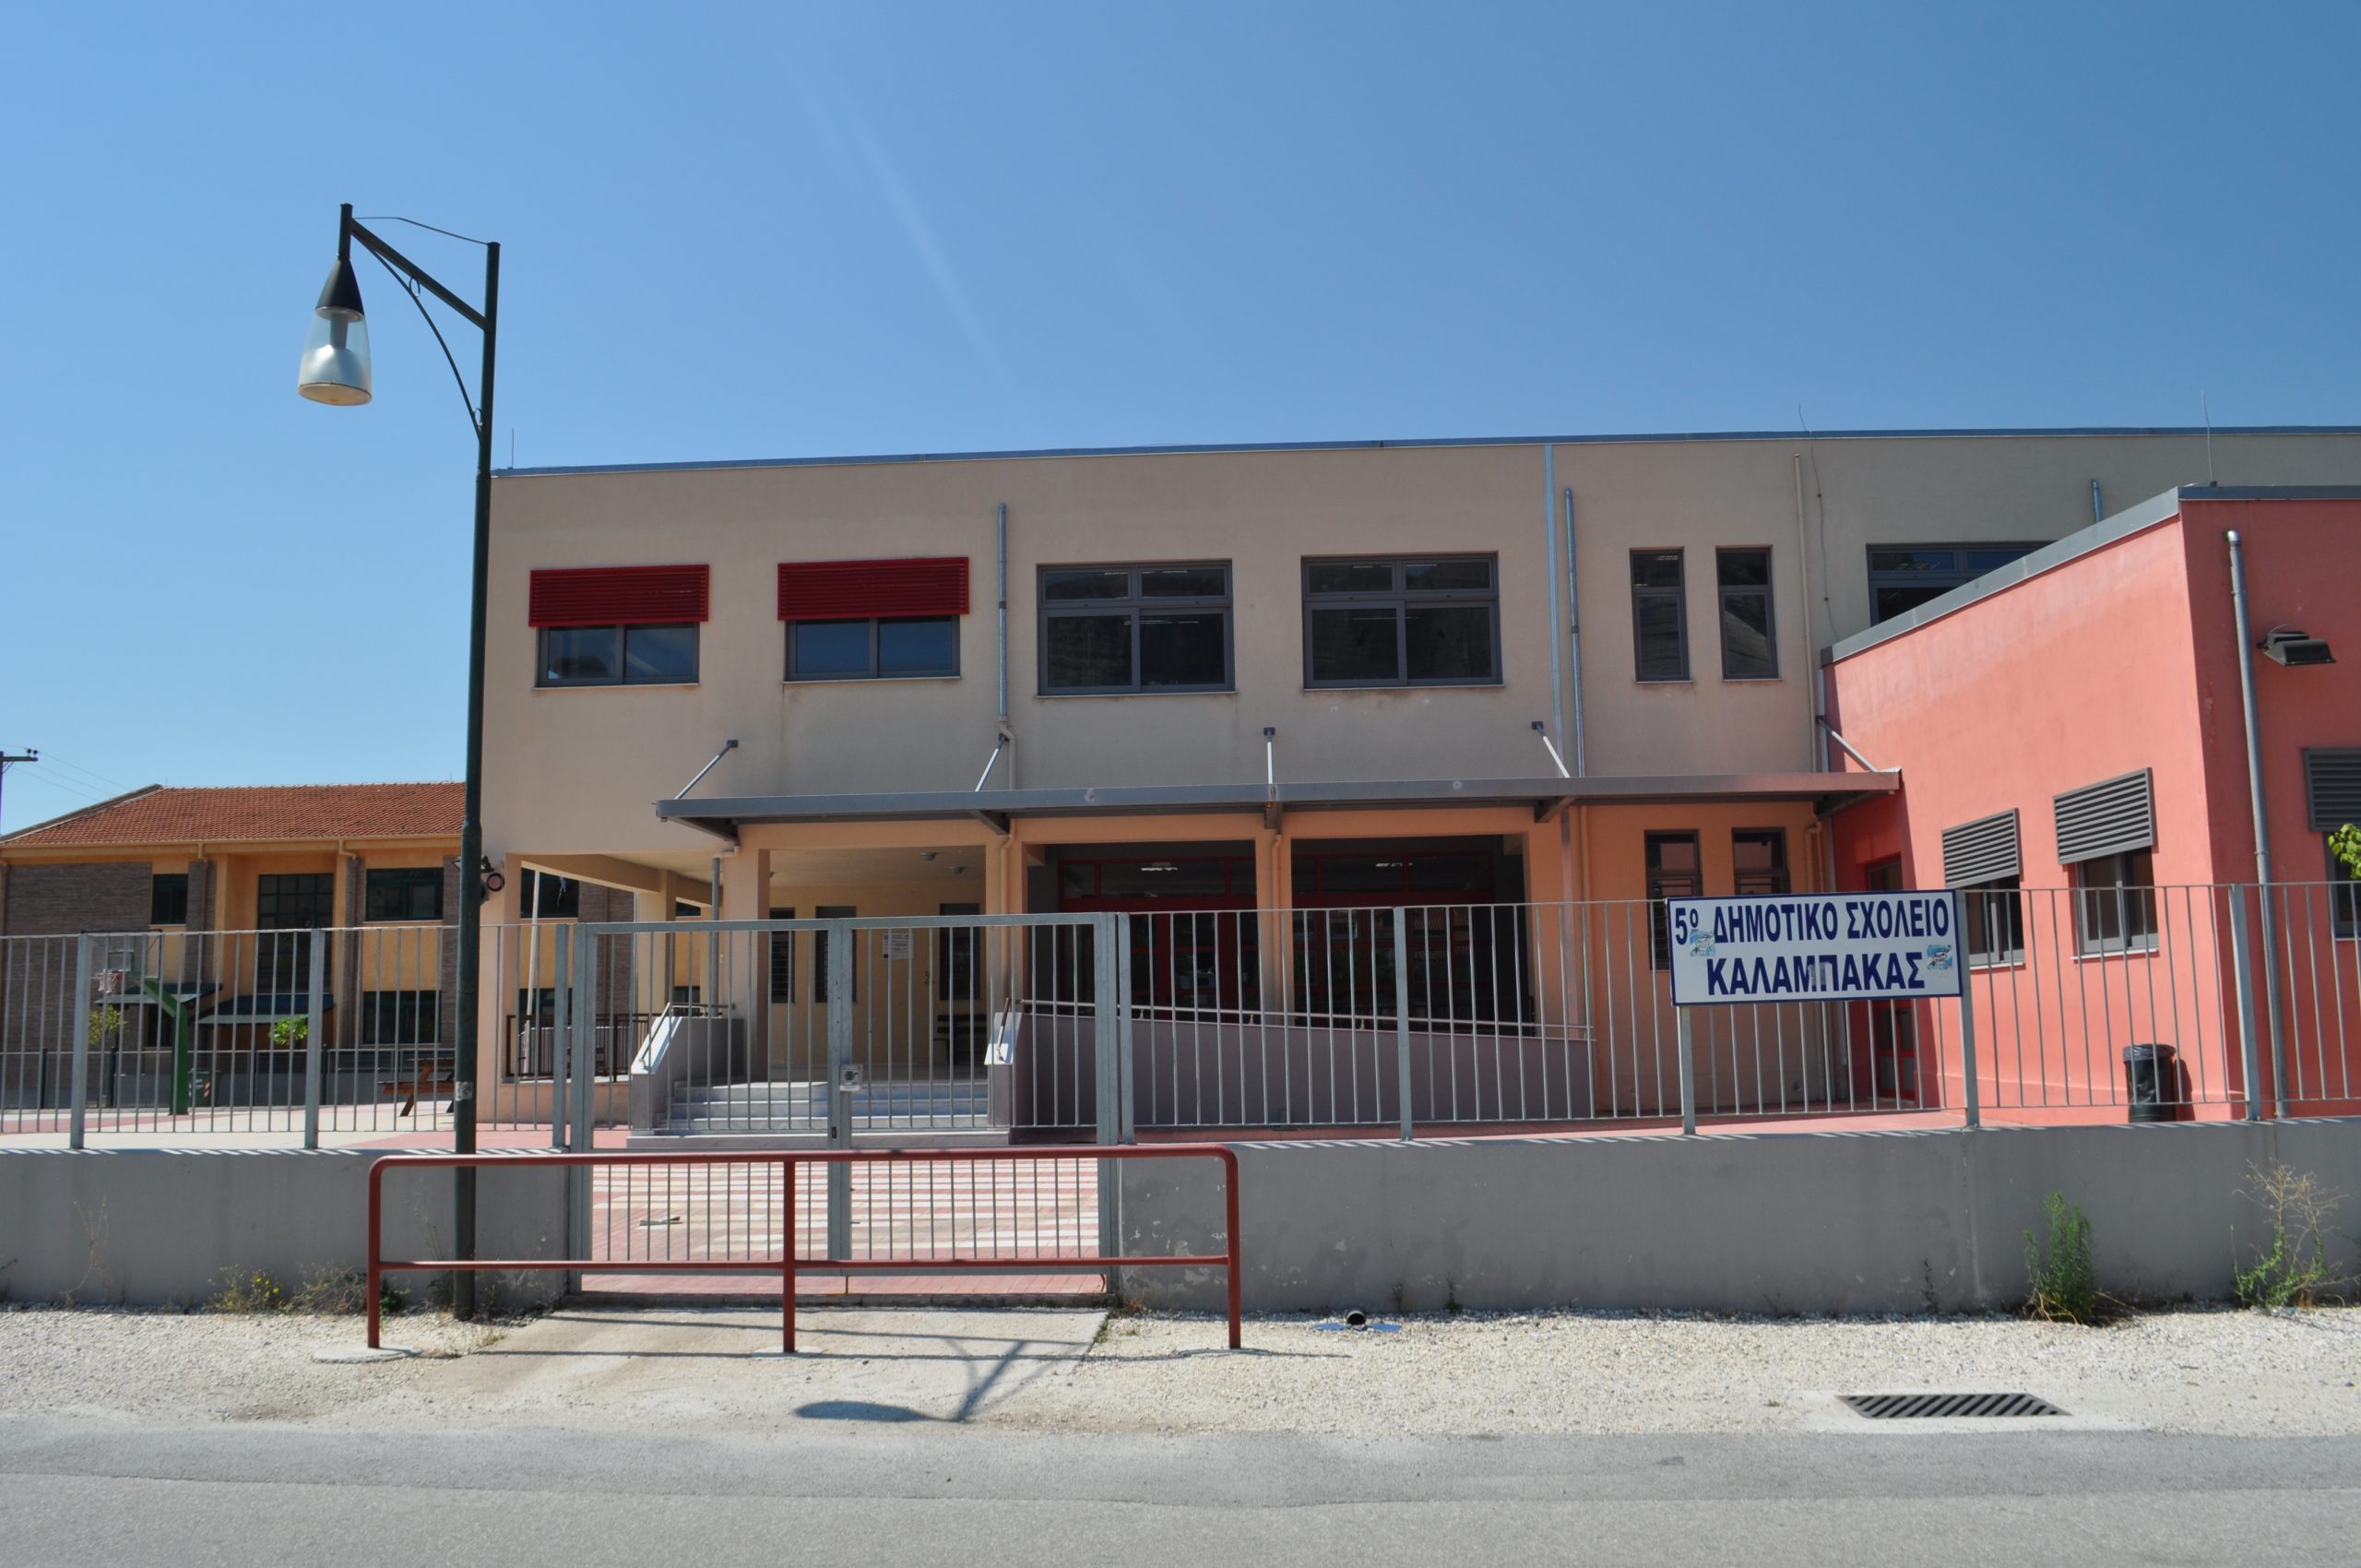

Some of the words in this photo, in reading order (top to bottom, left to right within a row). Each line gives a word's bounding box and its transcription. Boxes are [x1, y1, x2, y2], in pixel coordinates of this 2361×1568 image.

[1714, 902, 1839, 944] ΔΗΜΟΤΙΚΟ
[1845, 898, 1949, 939] ΣΧΟΛΕΙΟ
[1707, 952, 1926, 995] ΚΑΛΑΜΠΑΚΑΣ
